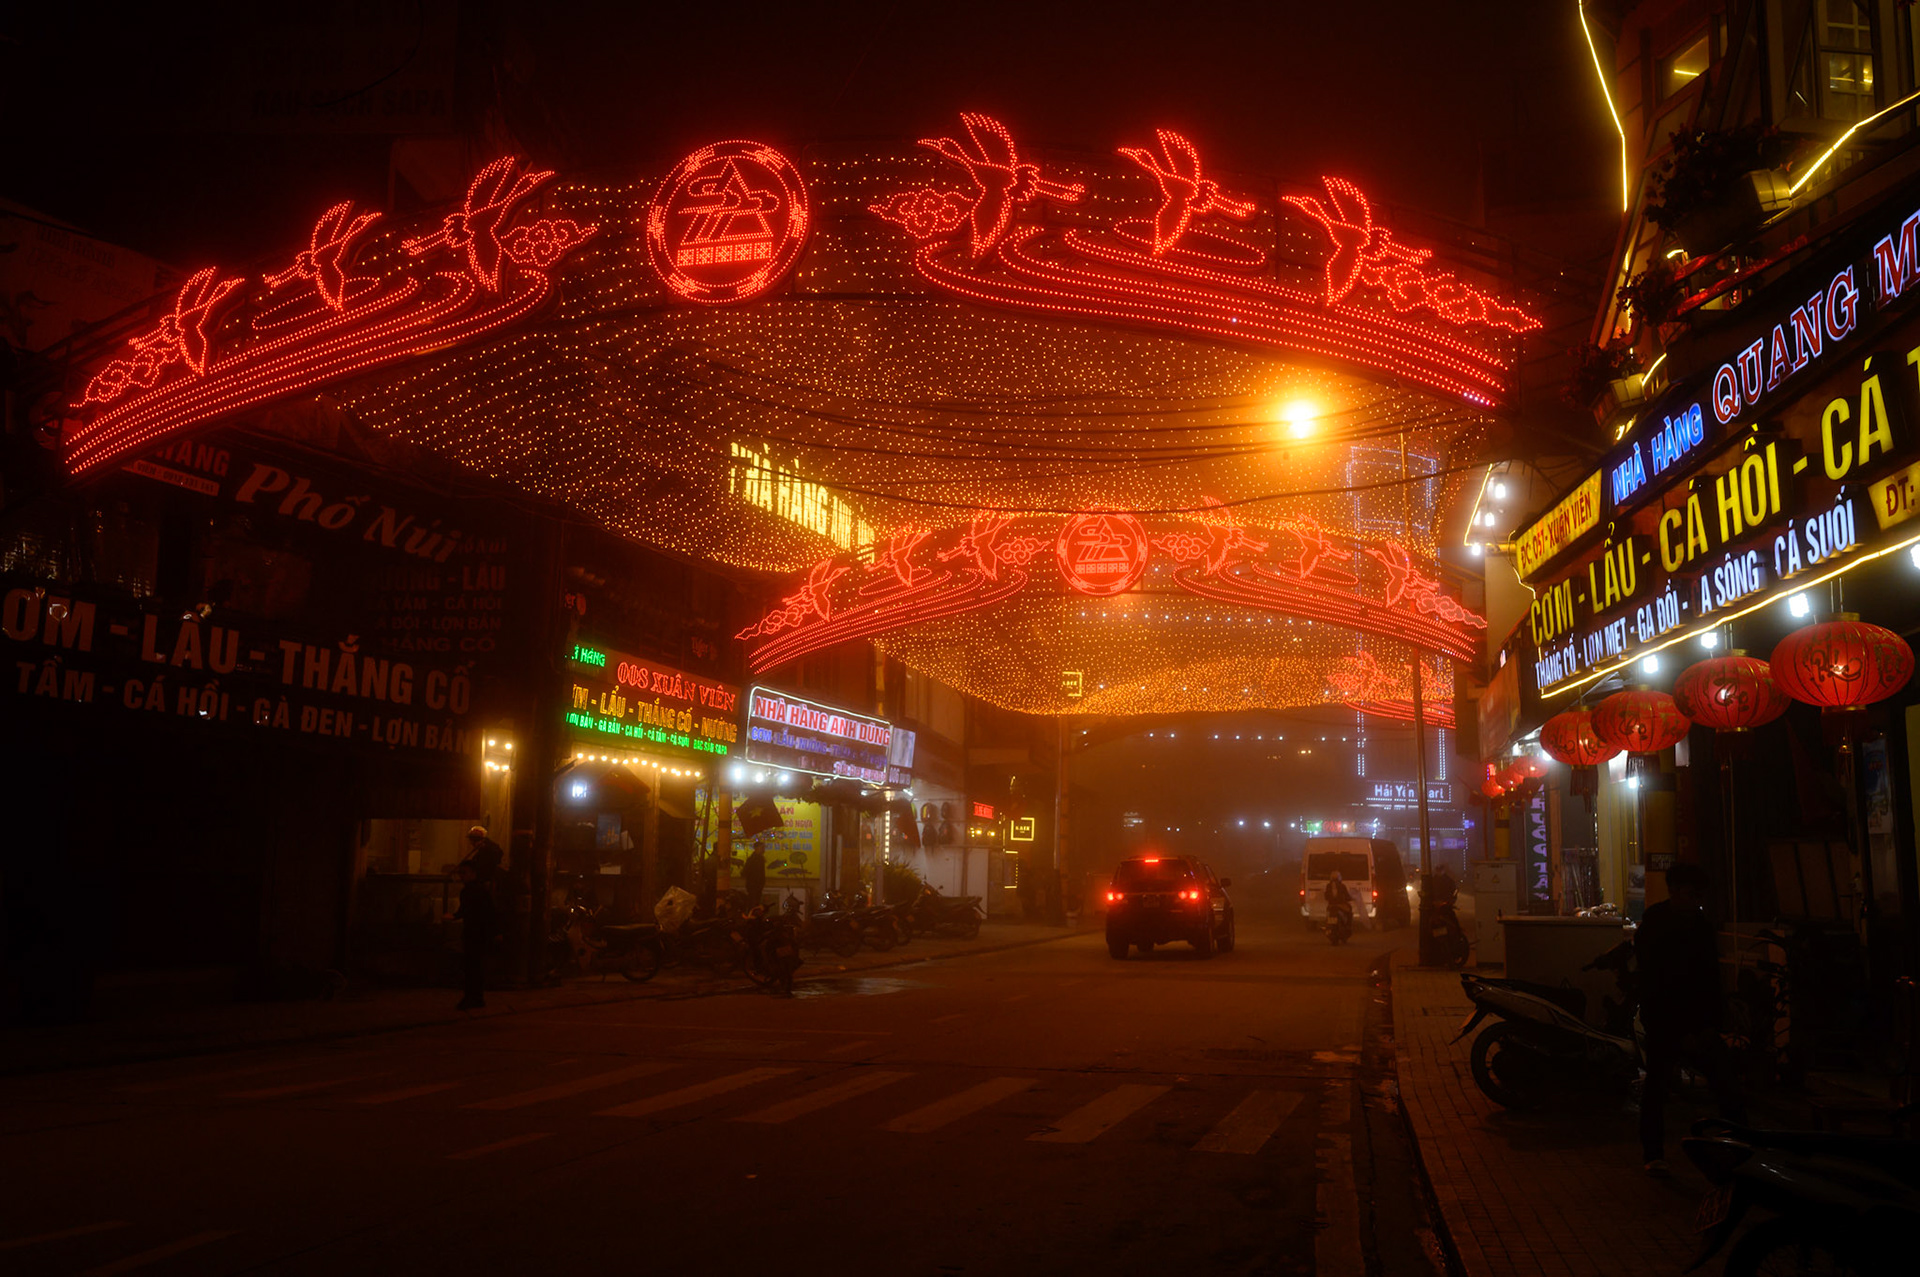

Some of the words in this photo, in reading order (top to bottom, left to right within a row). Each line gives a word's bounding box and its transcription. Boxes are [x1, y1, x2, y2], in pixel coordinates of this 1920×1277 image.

[1612, 441, 1646, 506] NHÀ
[1651, 402, 1704, 476] HÀNG
[1712, 264, 1859, 425] QUANG
[235, 462, 371, 531] Phố
[363, 504, 463, 564] Núi
[1530, 578, 1575, 647] CƠM
[1589, 521, 1636, 615] LẨU
[1659, 479, 1709, 573] CÁ
[1716, 423, 1781, 543] HỒI
[1821, 355, 1894, 481] CÁ
[1715, 552, 1760, 607] SÔNG
[1774, 519, 1802, 578] CÁ
[1805, 485, 1856, 565] SUỐI
[122, 674, 166, 713] CÁ
[252, 695, 291, 730] GÀ
[300, 704, 354, 739] ĐEN
[372, 714, 419, 750] LỢN
[279, 634, 415, 705] THẮNG
[425, 660, 476, 715] CỐ
[600, 685, 627, 718] LẨU
[650, 673, 697, 702] XUÂN
[698, 684, 736, 712] VIÊN
[751, 726, 772, 743] CƠM
[754, 696, 786, 722] NHÀ
[788, 703, 828, 732] HÀNG
[830, 717, 858, 740] ANH
[1428, 787, 1444, 799] art
